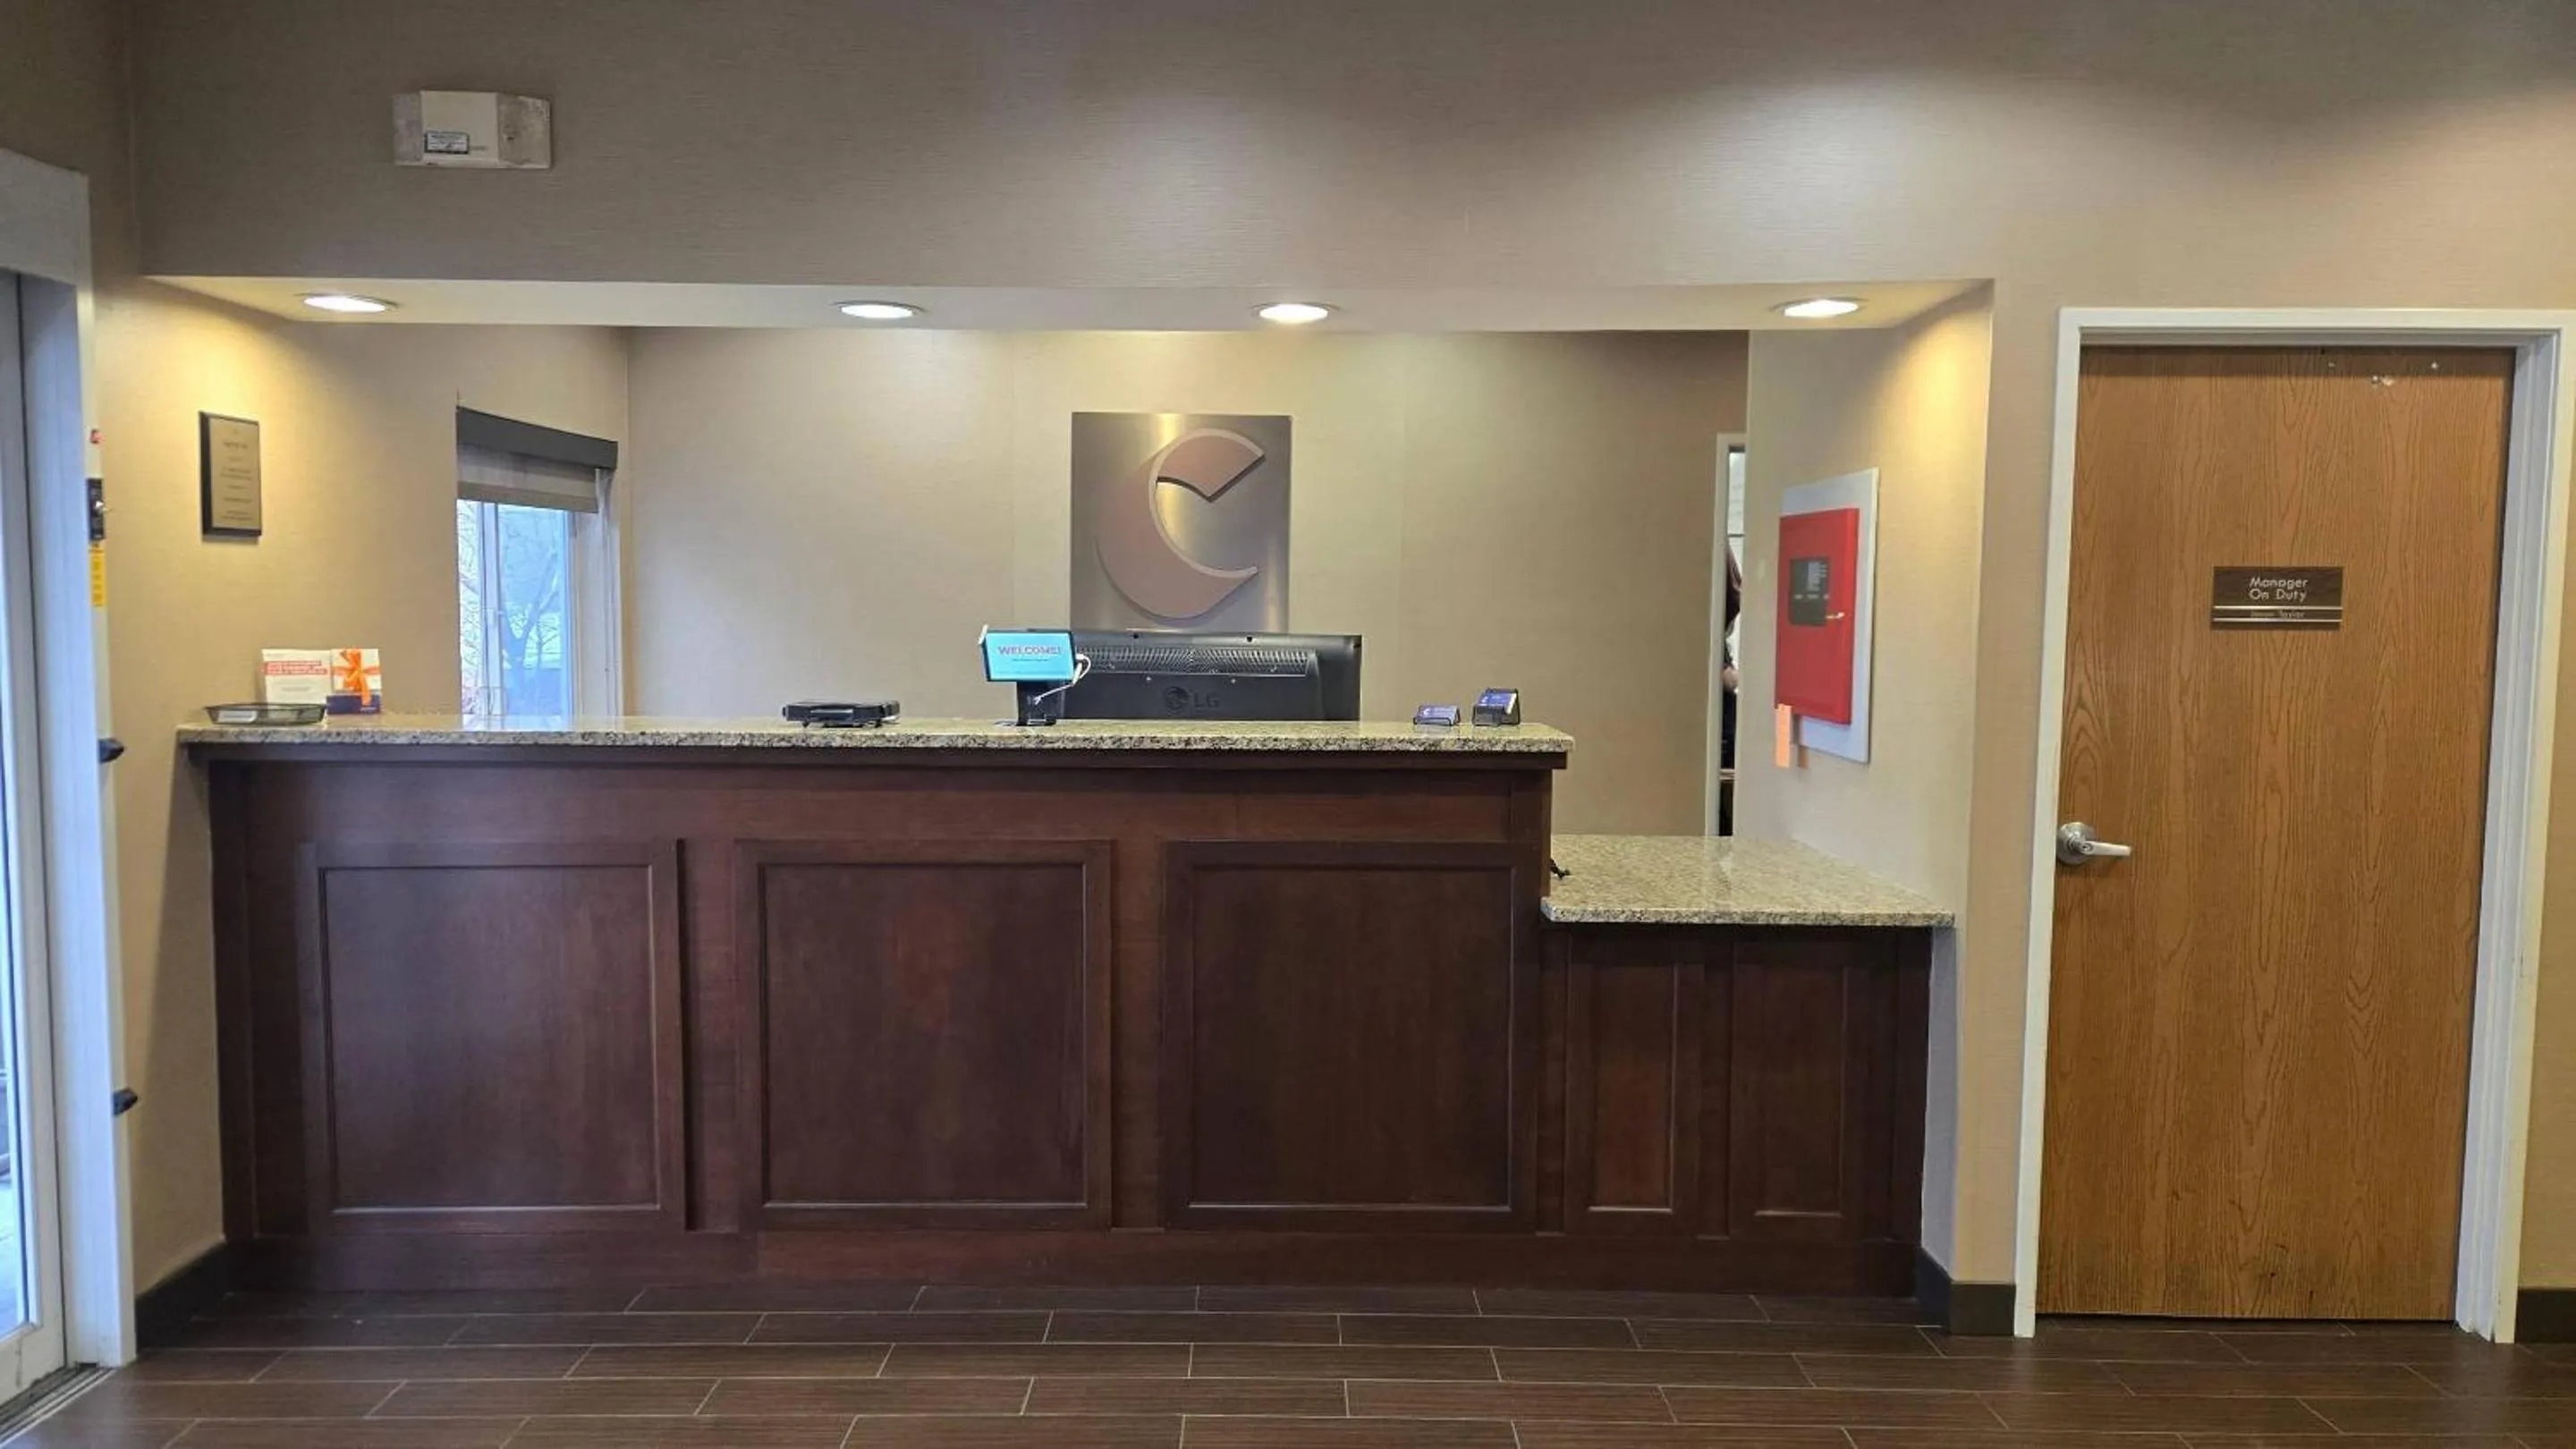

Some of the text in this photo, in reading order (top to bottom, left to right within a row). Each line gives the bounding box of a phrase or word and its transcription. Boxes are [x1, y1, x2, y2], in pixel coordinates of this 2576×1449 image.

[2249, 577, 2309, 590] Manager
[2249, 588, 2307, 603] On Duty
[1194, 692, 1221, 708] LG
